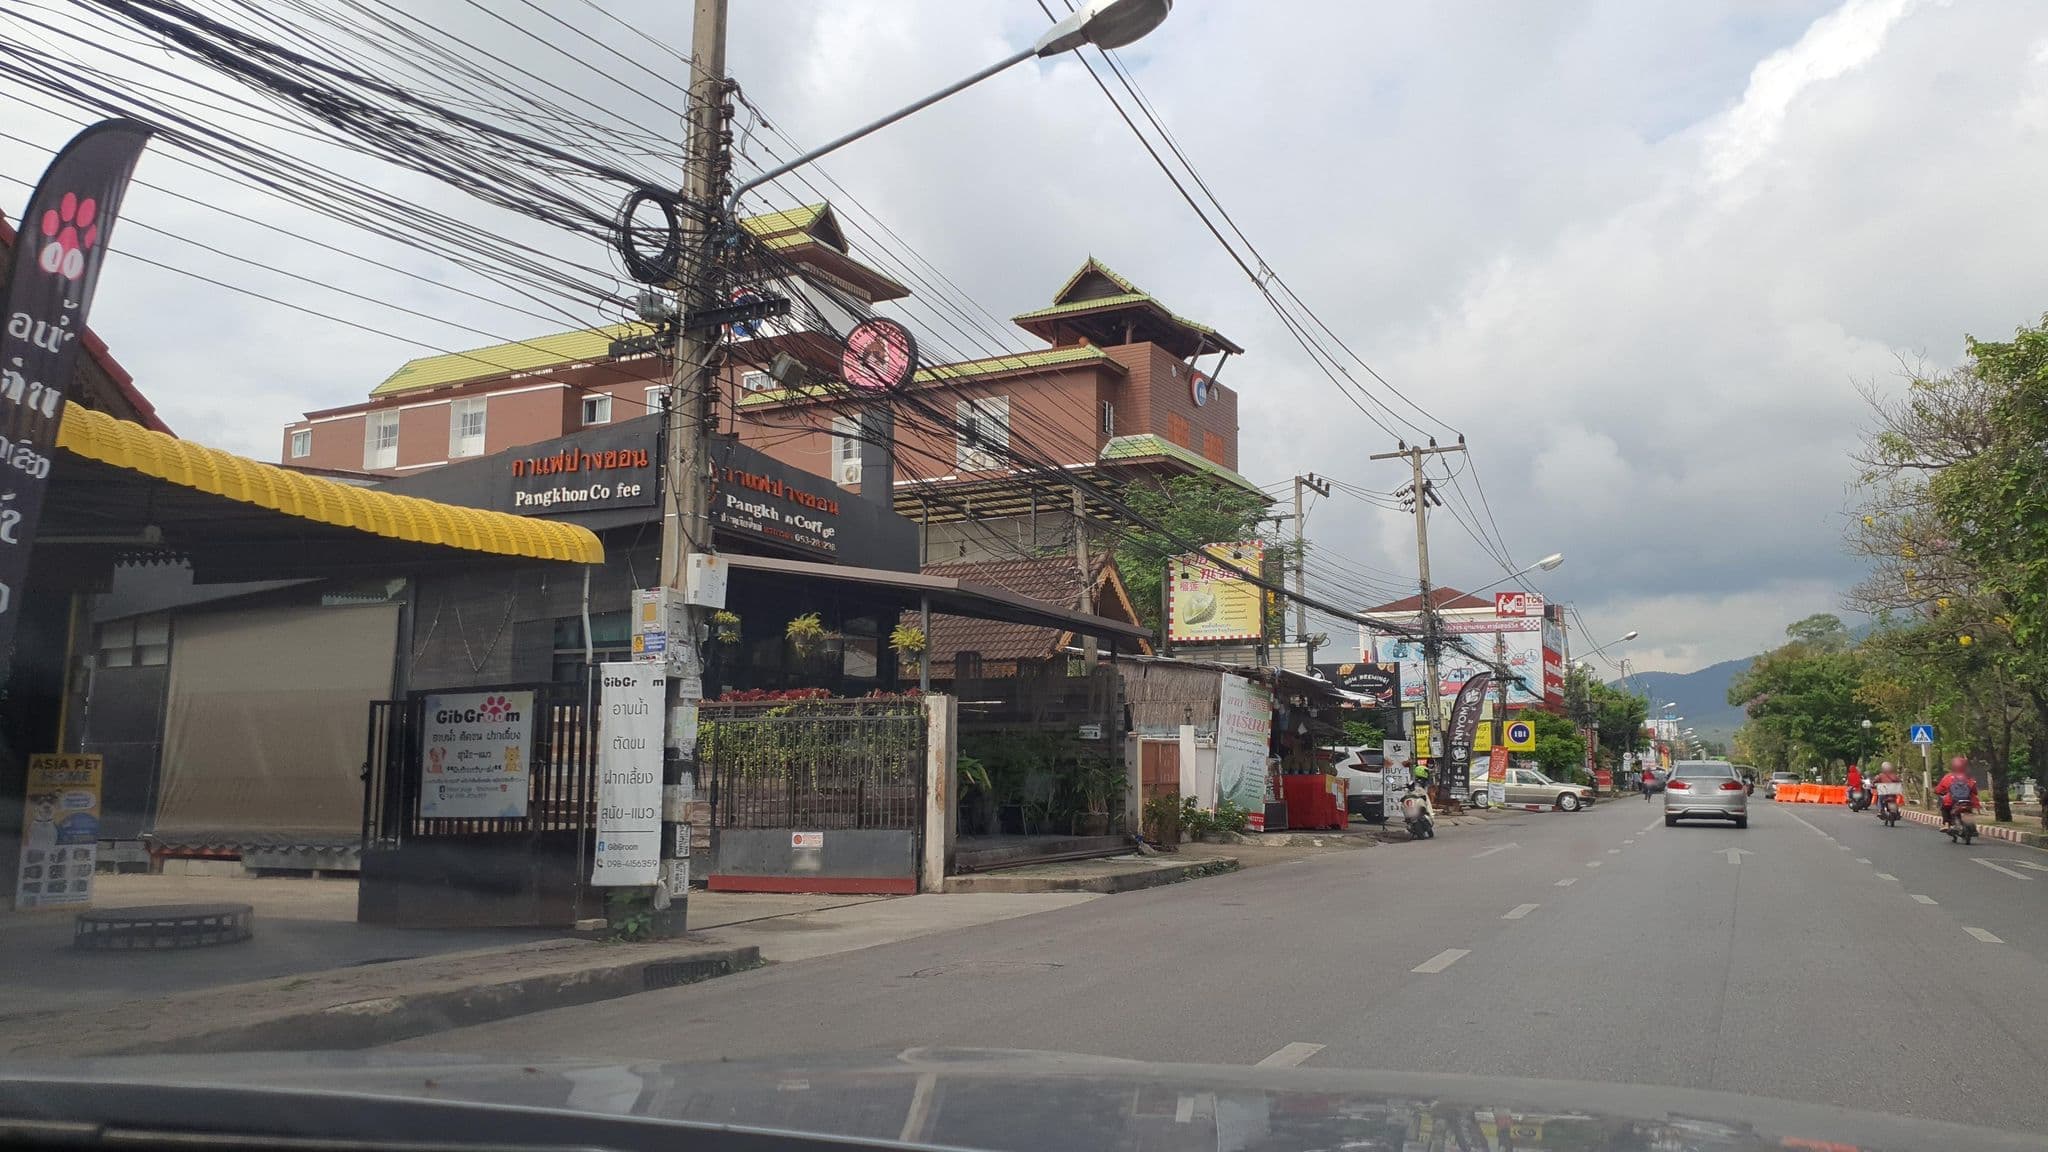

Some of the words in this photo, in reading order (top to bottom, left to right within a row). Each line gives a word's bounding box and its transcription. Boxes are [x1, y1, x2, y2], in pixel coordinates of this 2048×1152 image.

[514, 485, 588, 507] Pangkhon
[726, 493, 794, 526] Pangkhn
[603, 676, 665, 688] GibGrm
[612, 697, 649, 716] อาบน้ำ
